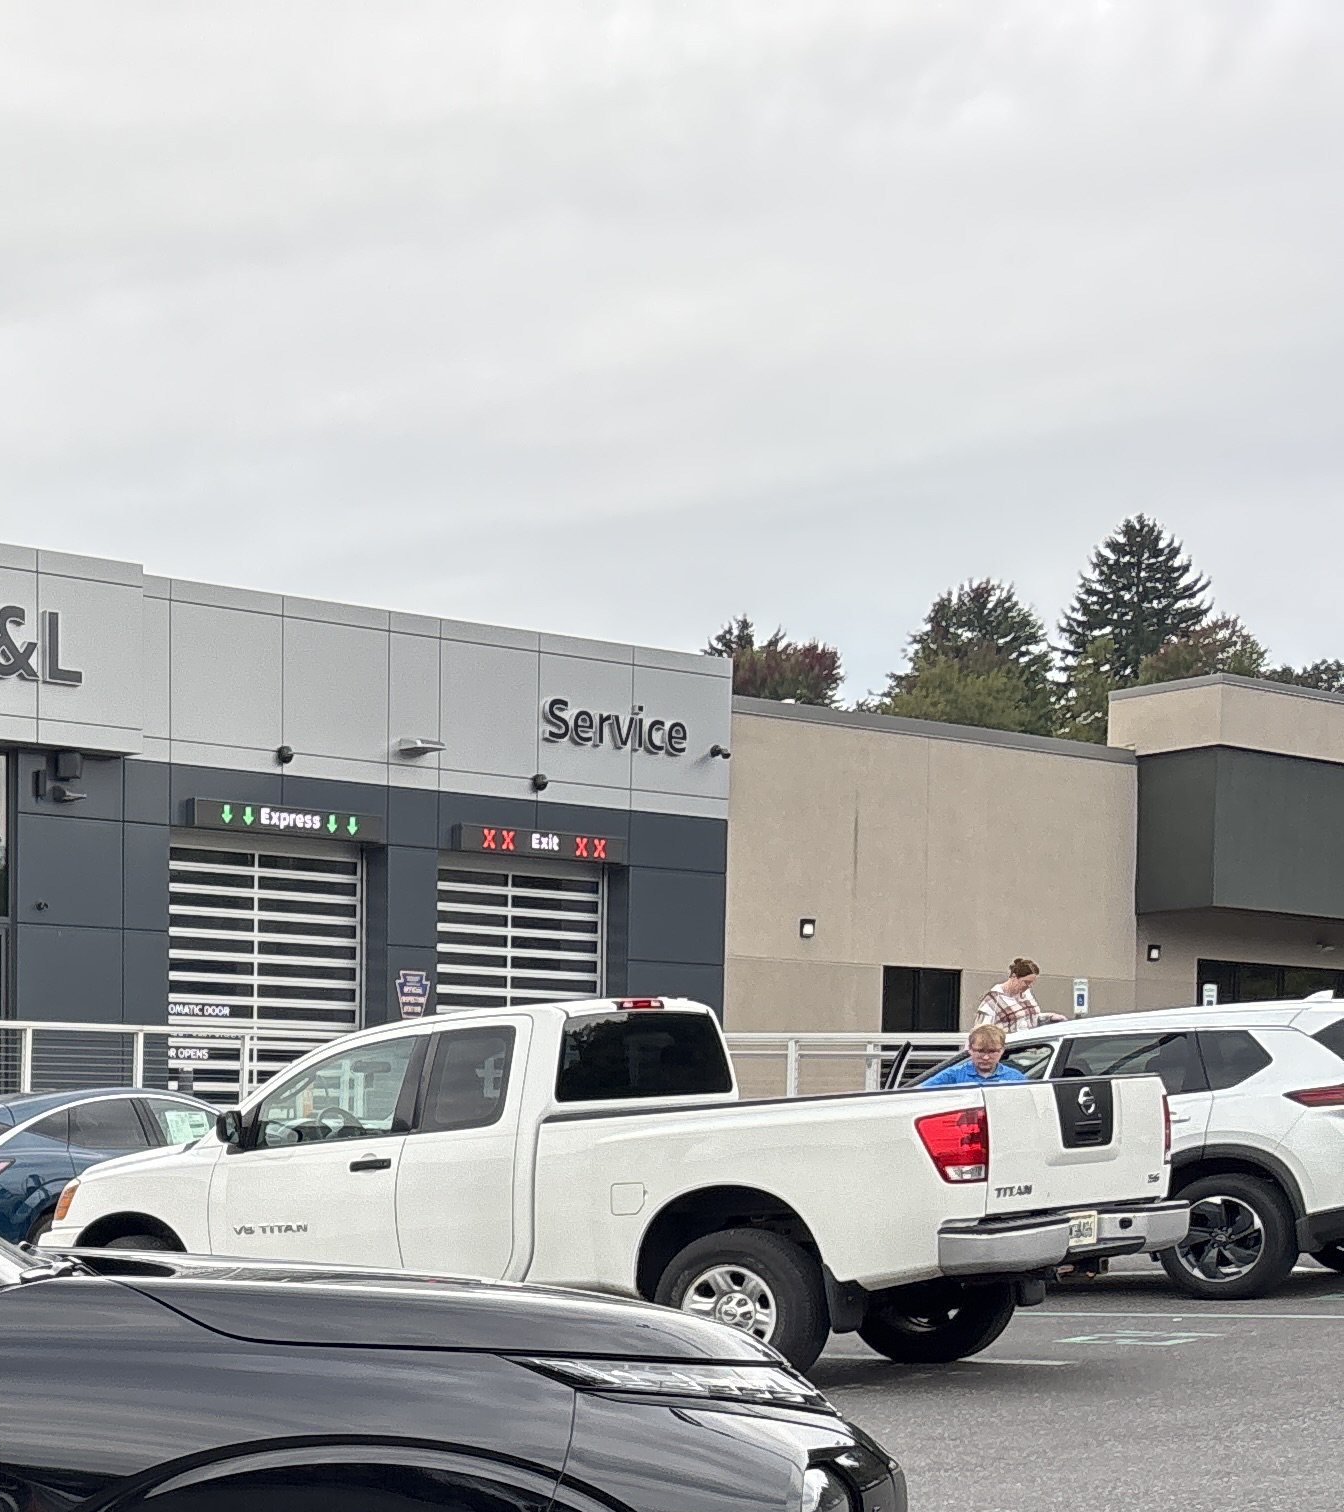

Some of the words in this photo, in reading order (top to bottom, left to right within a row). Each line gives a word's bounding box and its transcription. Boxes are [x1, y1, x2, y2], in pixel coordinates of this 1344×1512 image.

[543, 697, 688, 755] Service
[261, 808, 321, 829] Express
[531, 833, 560, 851] Exit
[204, 1005, 230, 1017] DOOR
[178, 1048, 209, 1060] OPENS
[994, 1184, 1032, 1199] TITAN
[258, 1223, 308, 1235] TITAN
